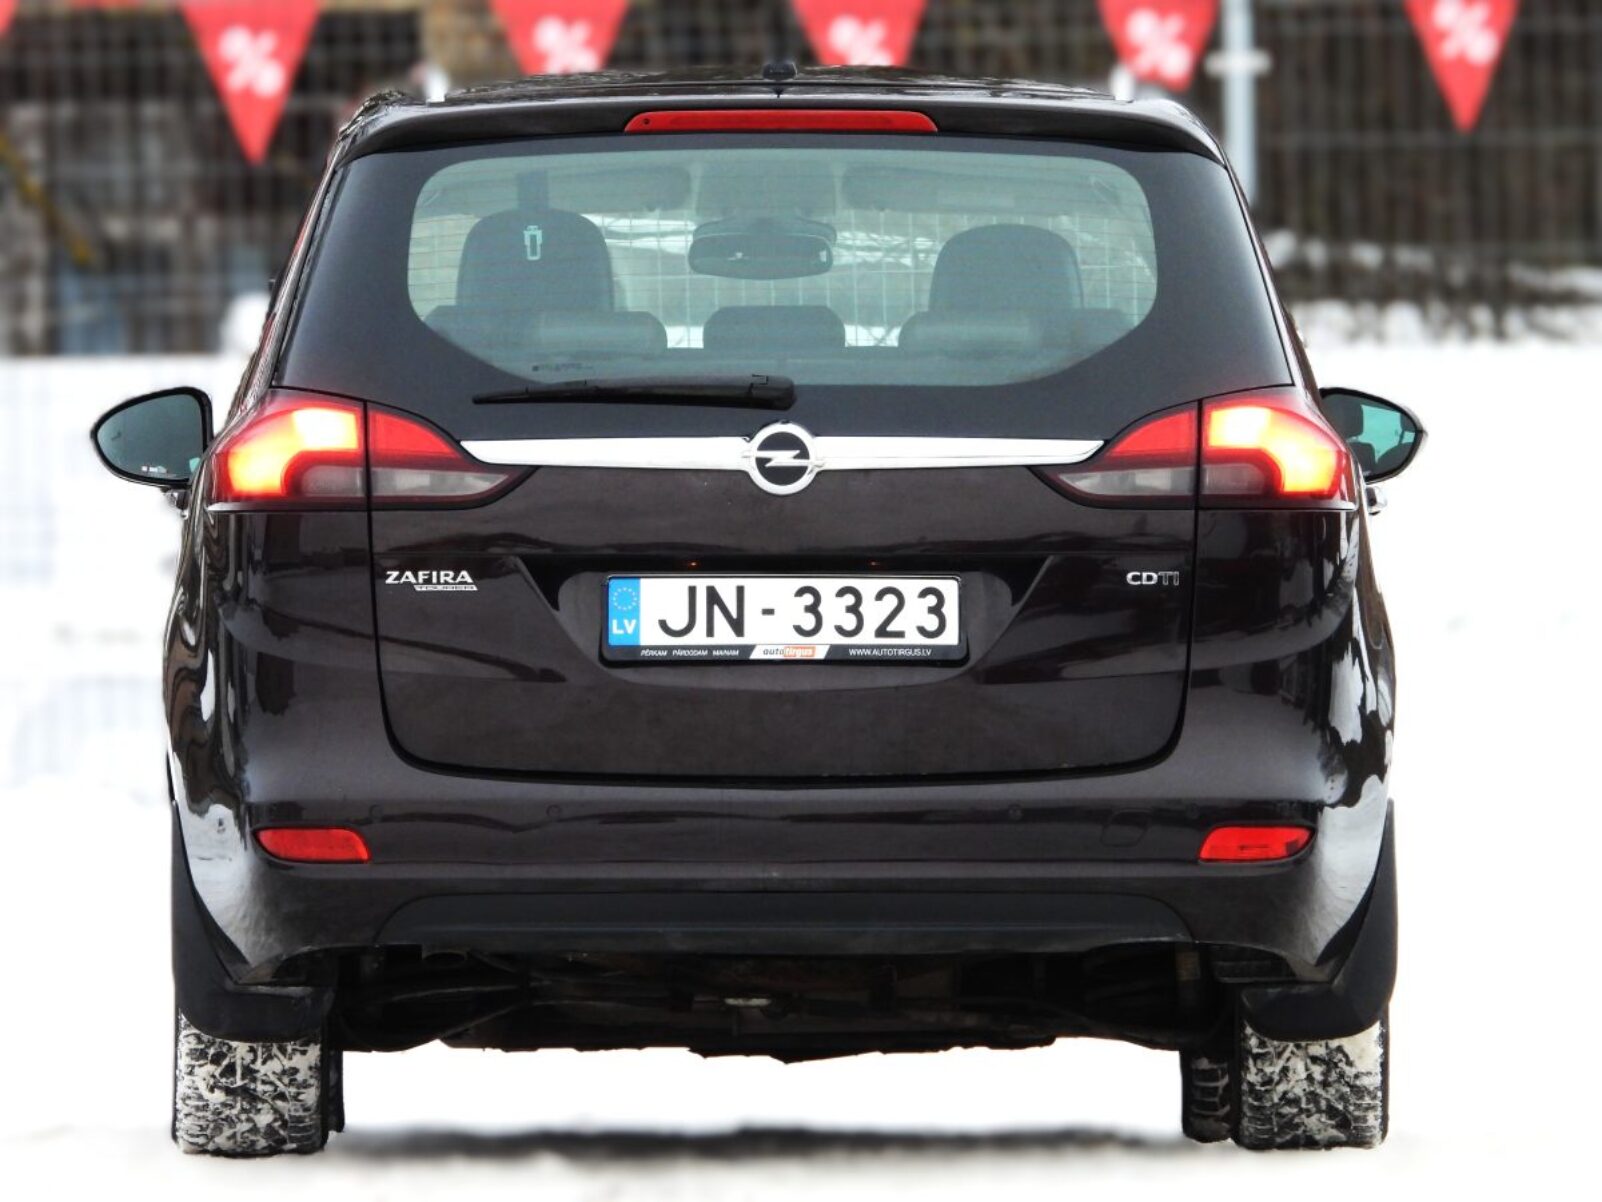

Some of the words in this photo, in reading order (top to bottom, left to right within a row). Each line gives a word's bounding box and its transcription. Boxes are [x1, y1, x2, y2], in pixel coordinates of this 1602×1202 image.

[1126, 9, 1194, 79] %
[218, 25, 286, 95] %
[385, 570, 474, 584] ZAFIRA
[1126, 571, 1180, 586] CDTI
[612, 619, 637, 634] LV
[849, 648, 932, 657] WWW.AUTOTIRGUS.LV
